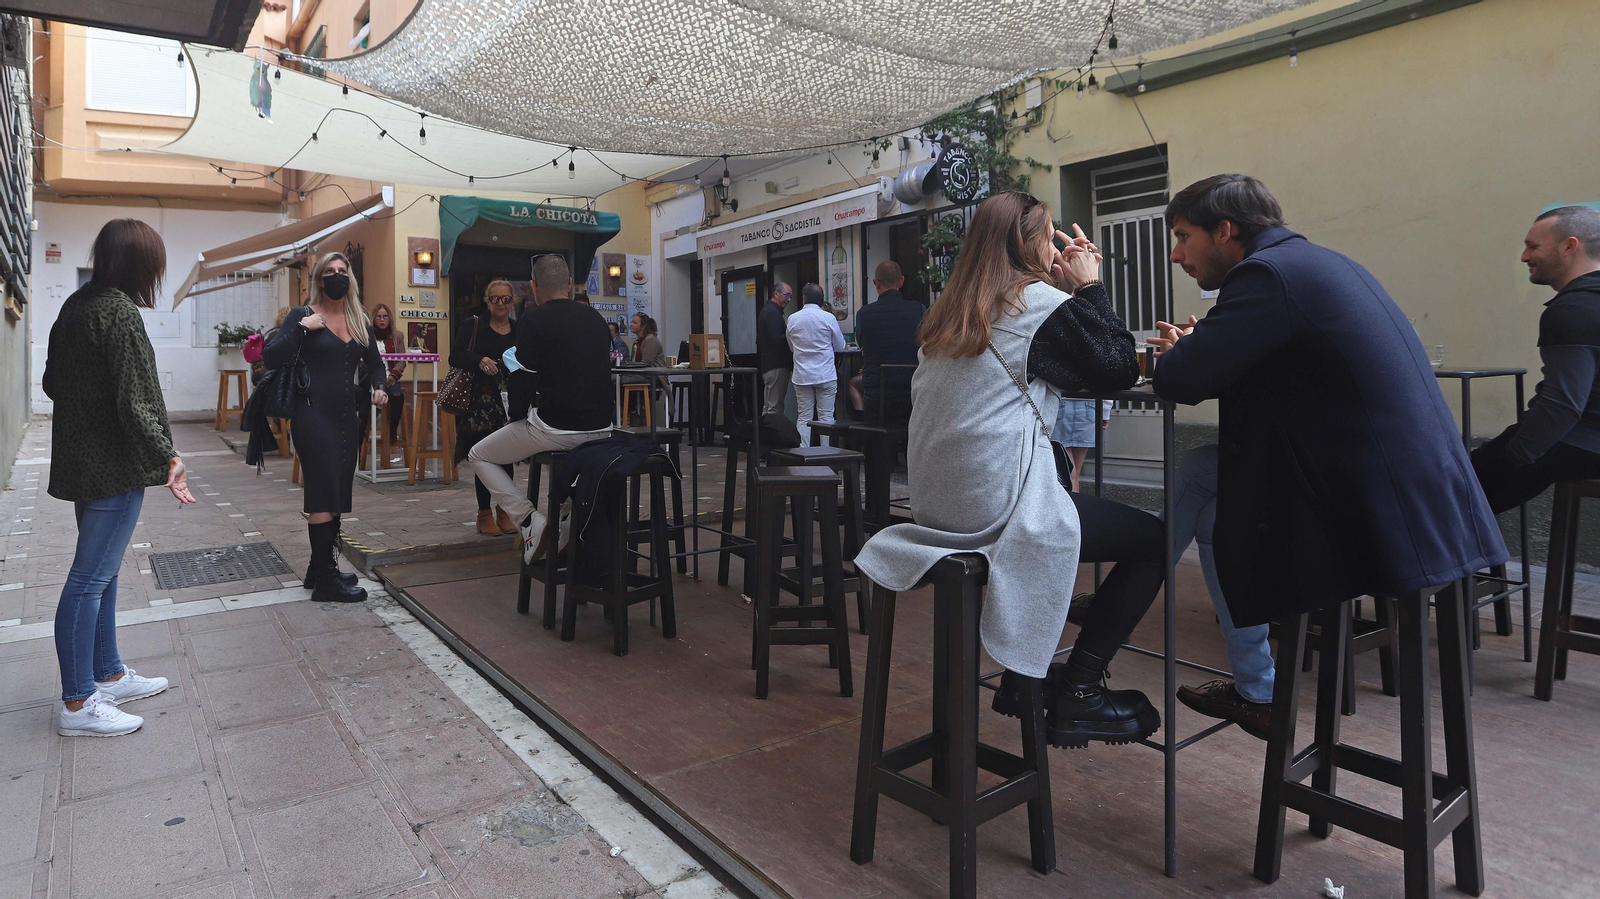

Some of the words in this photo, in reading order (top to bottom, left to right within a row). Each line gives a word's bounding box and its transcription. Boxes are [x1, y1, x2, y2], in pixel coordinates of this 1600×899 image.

[509, 205, 531, 218] LA
[536, 208, 599, 226] CHICOTA
[834, 206, 866, 222] Cruzcampo
[740, 229, 771, 243] TABANCO
[784, 216, 821, 233] SACRISTIA
[703, 240, 726, 251] Cruzcampo
[400, 310, 448, 319] CHICOTA
